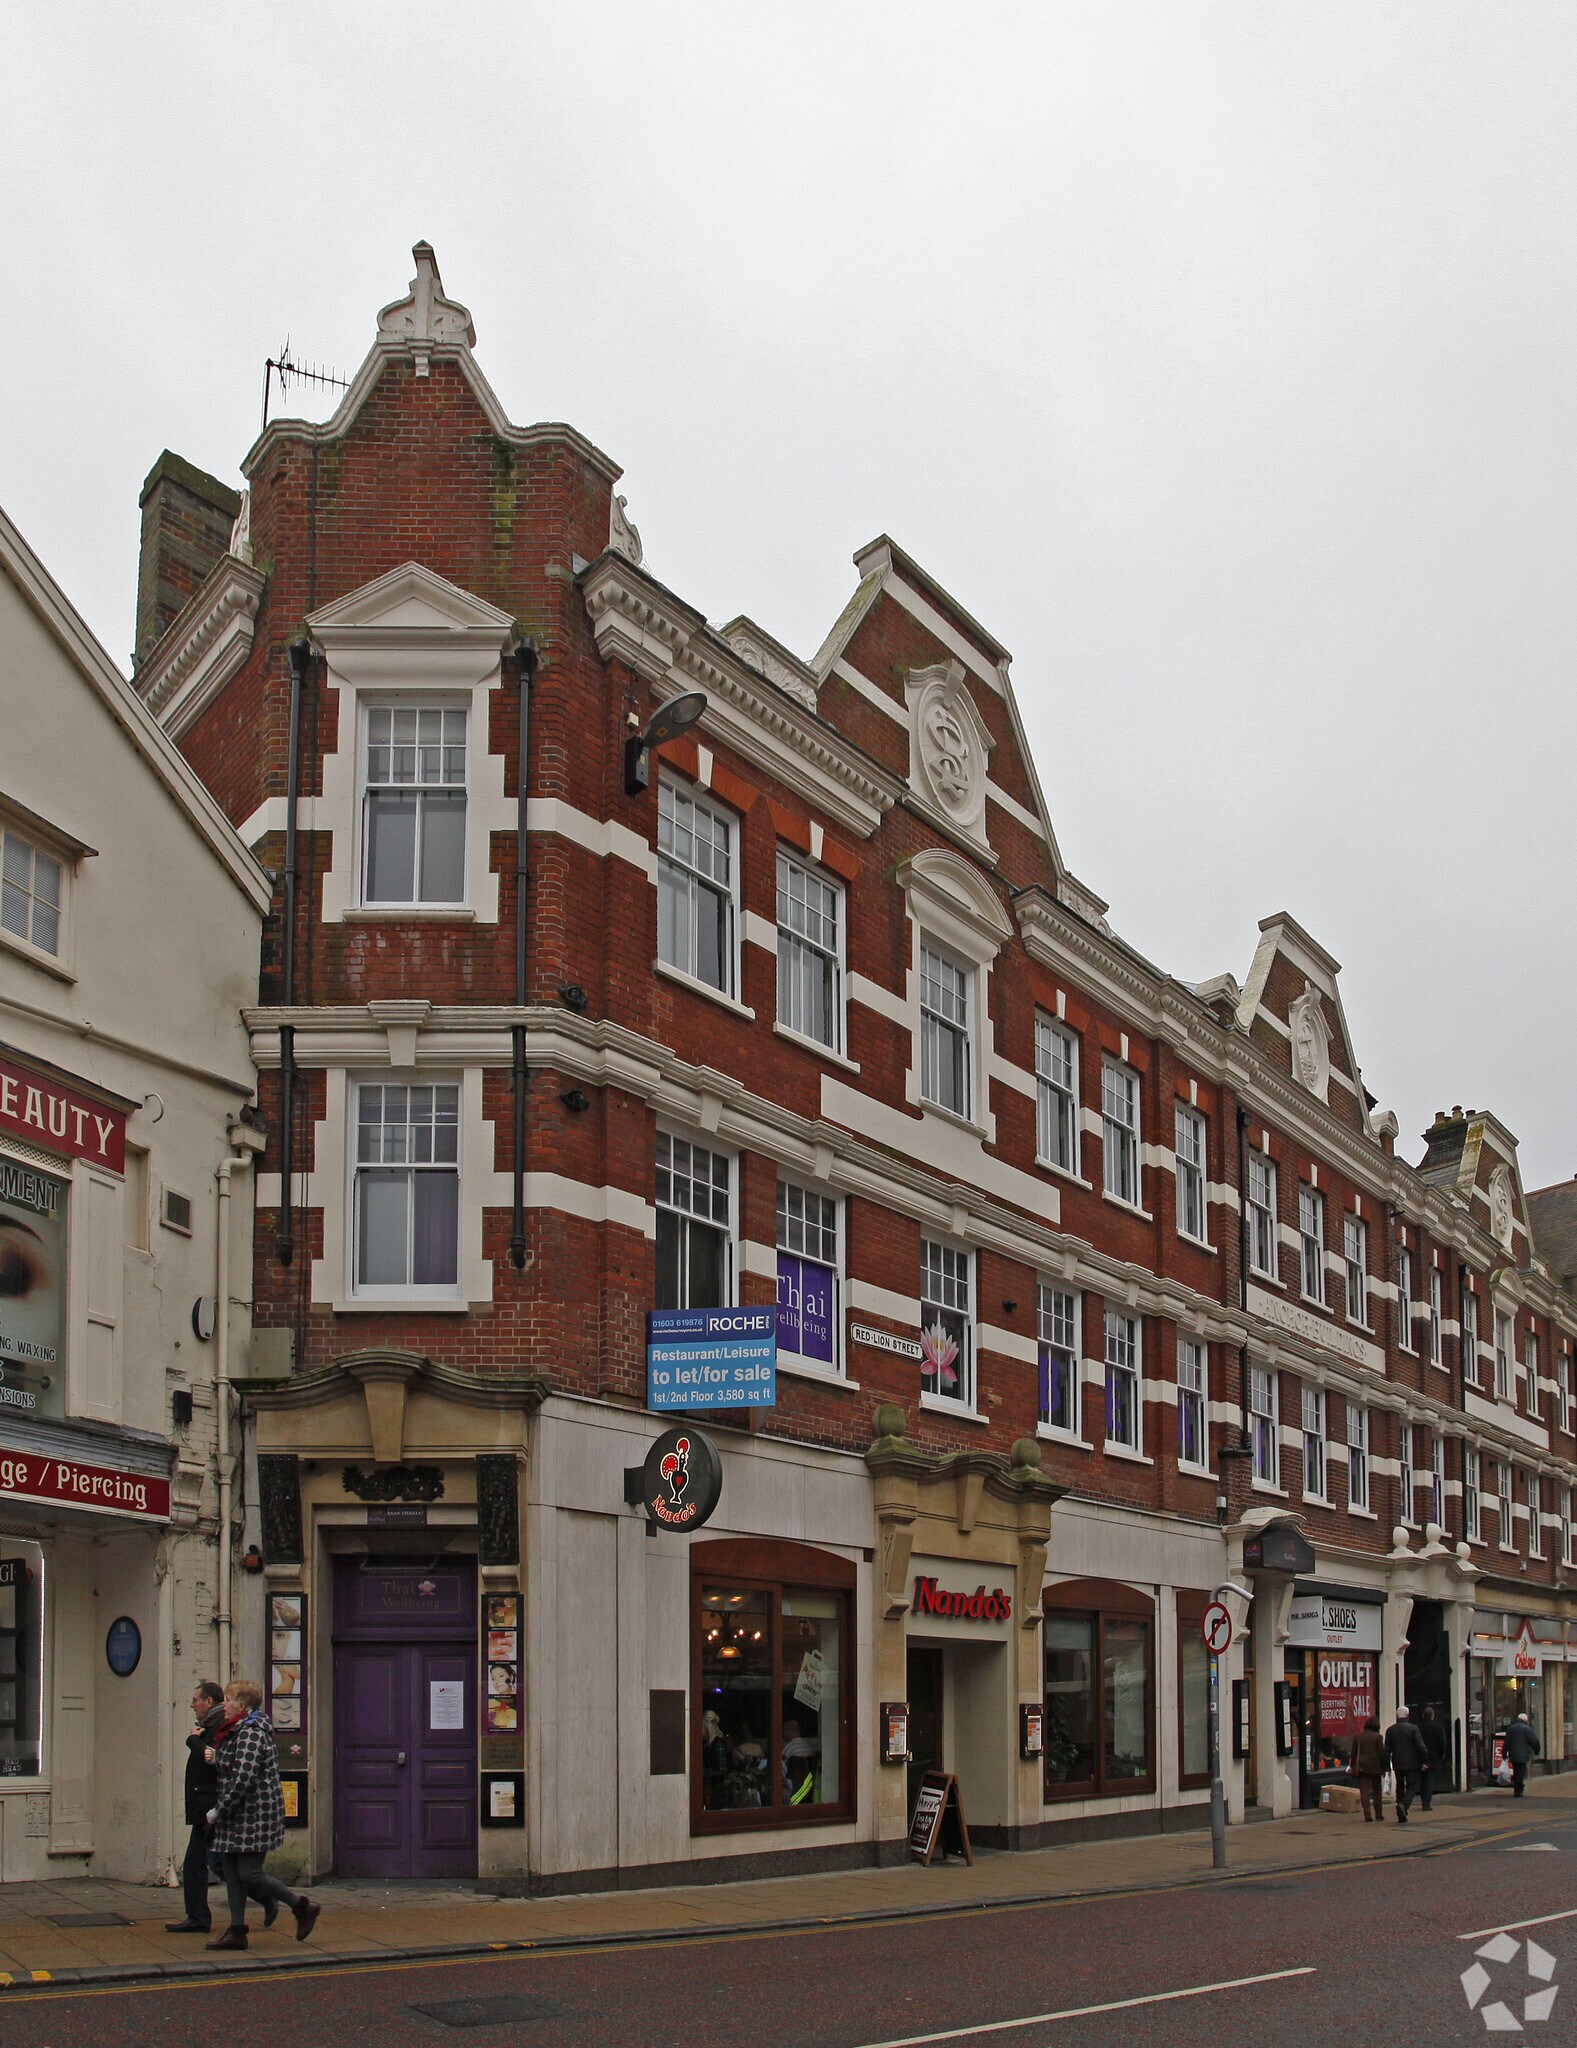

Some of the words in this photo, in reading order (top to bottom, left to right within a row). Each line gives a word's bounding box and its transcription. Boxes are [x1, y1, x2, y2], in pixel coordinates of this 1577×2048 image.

[0, 1073, 114, 1156] EAUTY
[676, 1318, 703, 1326] 619876
[709, 1316, 765, 1331] ROCHE
[776, 1310, 827, 1341] ellbeing
[17, 1340, 56, 1361] WAXING
[652, 1347, 770, 1361] Restaurant/Leisure
[892, 1339, 919, 1355] STREET
[652, 1368, 671, 1385] to
[675, 1366, 729, 1384] let/for
[734, 1364, 771, 1381] sale
[653, 1391, 688, 1403] 1st/2nd
[691, 1391, 714, 1402] Floor
[718, 1389, 744, 1402] 3,580
[748, 1391, 760, 1401] sq
[763, 1388, 770, 1398] ft
[1, 1459, 28, 1489] ge
[56, 1463, 147, 1510] Piercing
[651, 1494, 697, 1524] Nando's
[382, 1580, 415, 1595] Thai
[911, 1576, 1011, 1620] Nando's
[1301, 1611, 1319, 1620] SHOES
[1329, 1607, 1356, 1629] SHOES
[1327, 1635, 1343, 1643] OUTLET
[1320, 1660, 1372, 1688] OUTLET
[1321, 1700, 1347, 1708] EVERYTHING
[1353, 1695, 1371, 1717] SALE
[1321, 1708, 1347, 1719] REDUCED
